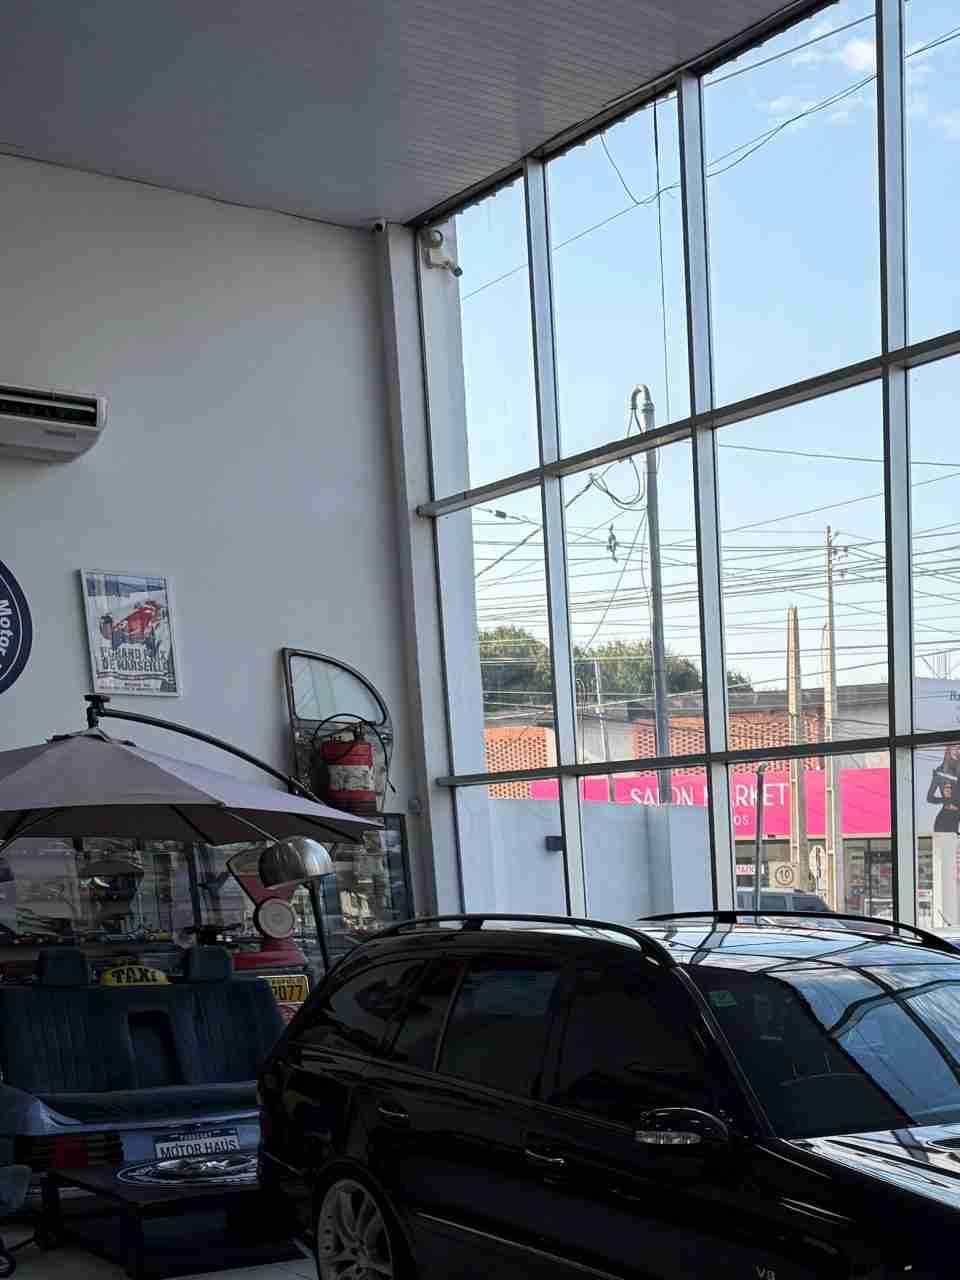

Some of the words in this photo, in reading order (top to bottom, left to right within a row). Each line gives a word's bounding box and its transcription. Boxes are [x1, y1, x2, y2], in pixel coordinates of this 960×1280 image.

[112, 967, 158, 984] TAXI
[160, 1143, 202, 1161] MOTOR
[204, 1138, 238, 1154] HAUS
[755, 1264, 776, 1280] V8
